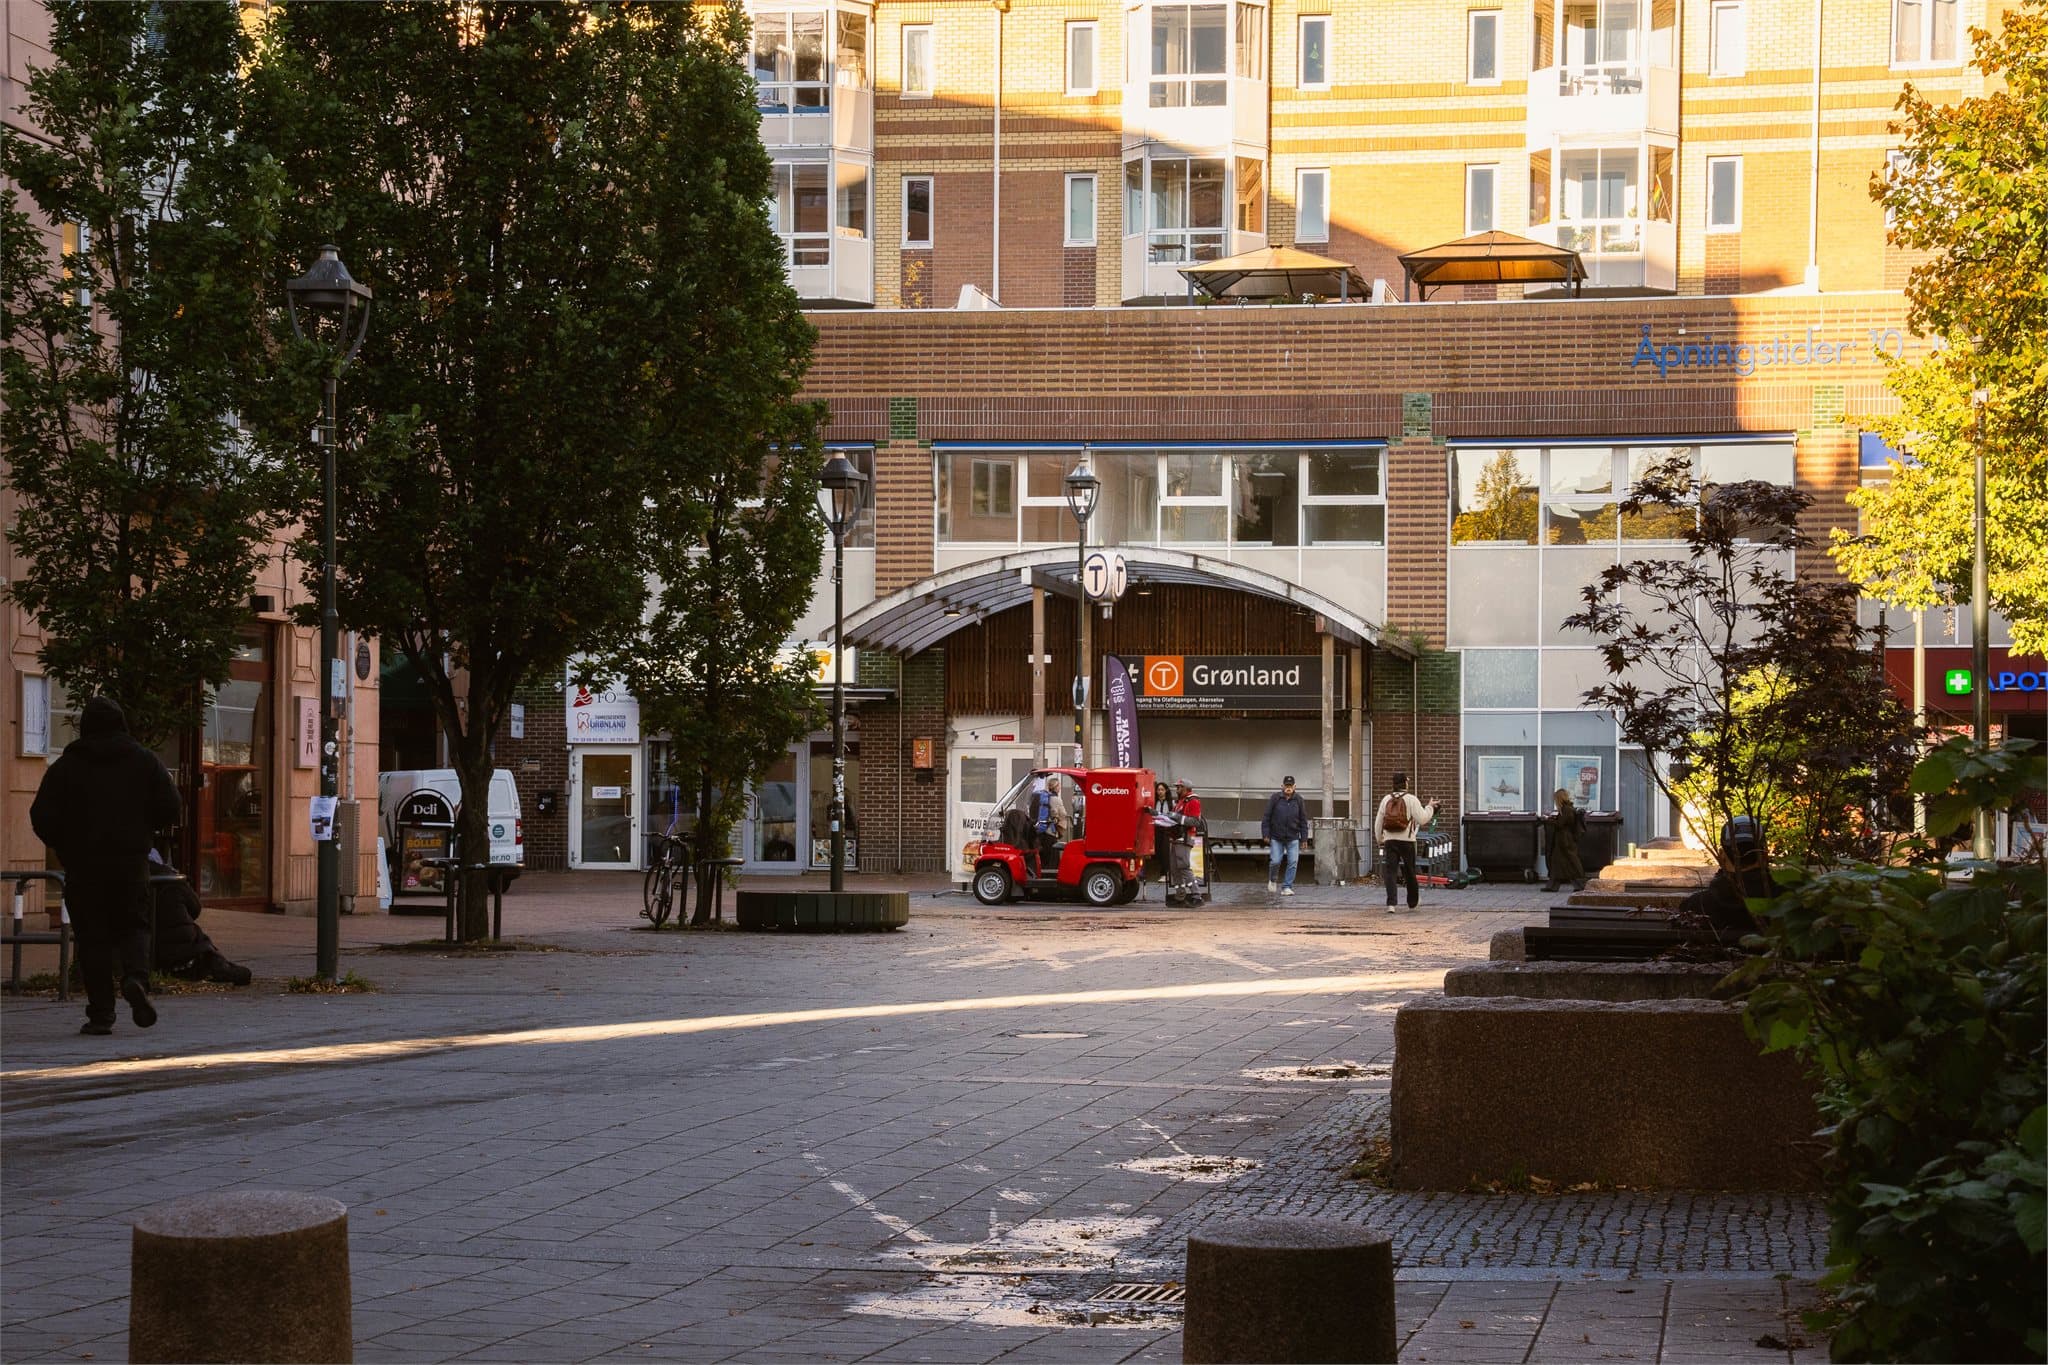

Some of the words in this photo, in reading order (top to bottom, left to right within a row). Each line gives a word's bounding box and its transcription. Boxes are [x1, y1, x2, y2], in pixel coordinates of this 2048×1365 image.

[1631, 324, 1857, 377] Åpningstider:
[1089, 565, 1103, 592] T
[1192, 665, 1300, 686] Grønland
[1102, 787, 1129, 796] posten
[413, 803, 438, 815] Deli
[962, 818, 981, 830] WAGYU
